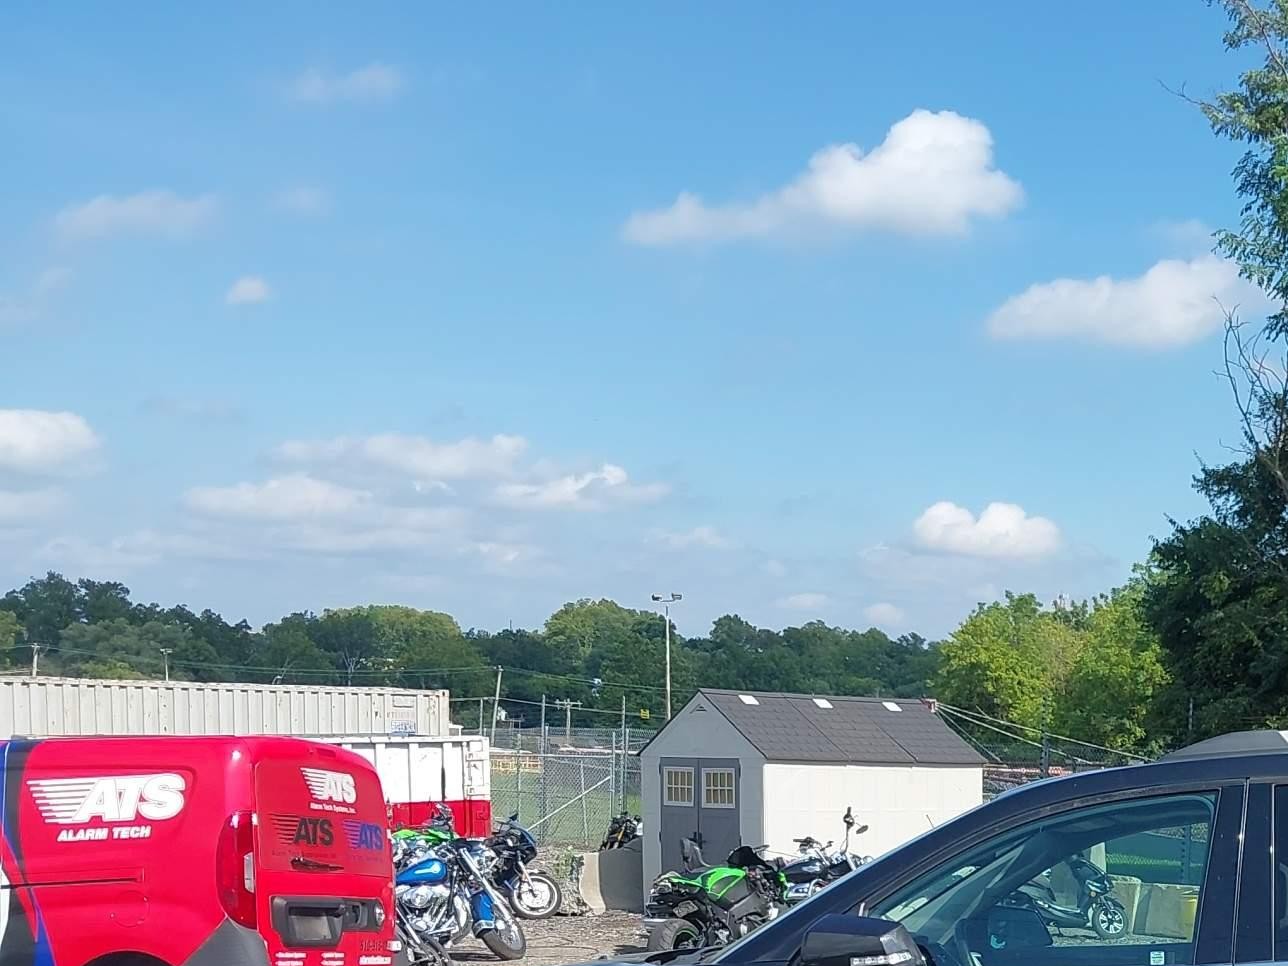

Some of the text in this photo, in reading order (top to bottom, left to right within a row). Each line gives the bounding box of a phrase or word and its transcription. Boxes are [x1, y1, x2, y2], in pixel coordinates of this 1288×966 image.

[71, 772, 186, 822] ATS
[323, 773, 357, 804] ATS
[56, 825, 152, 842] ALARM TECH
[293, 816, 335, 846] ATS
[357, 822, 384, 851] ATS
